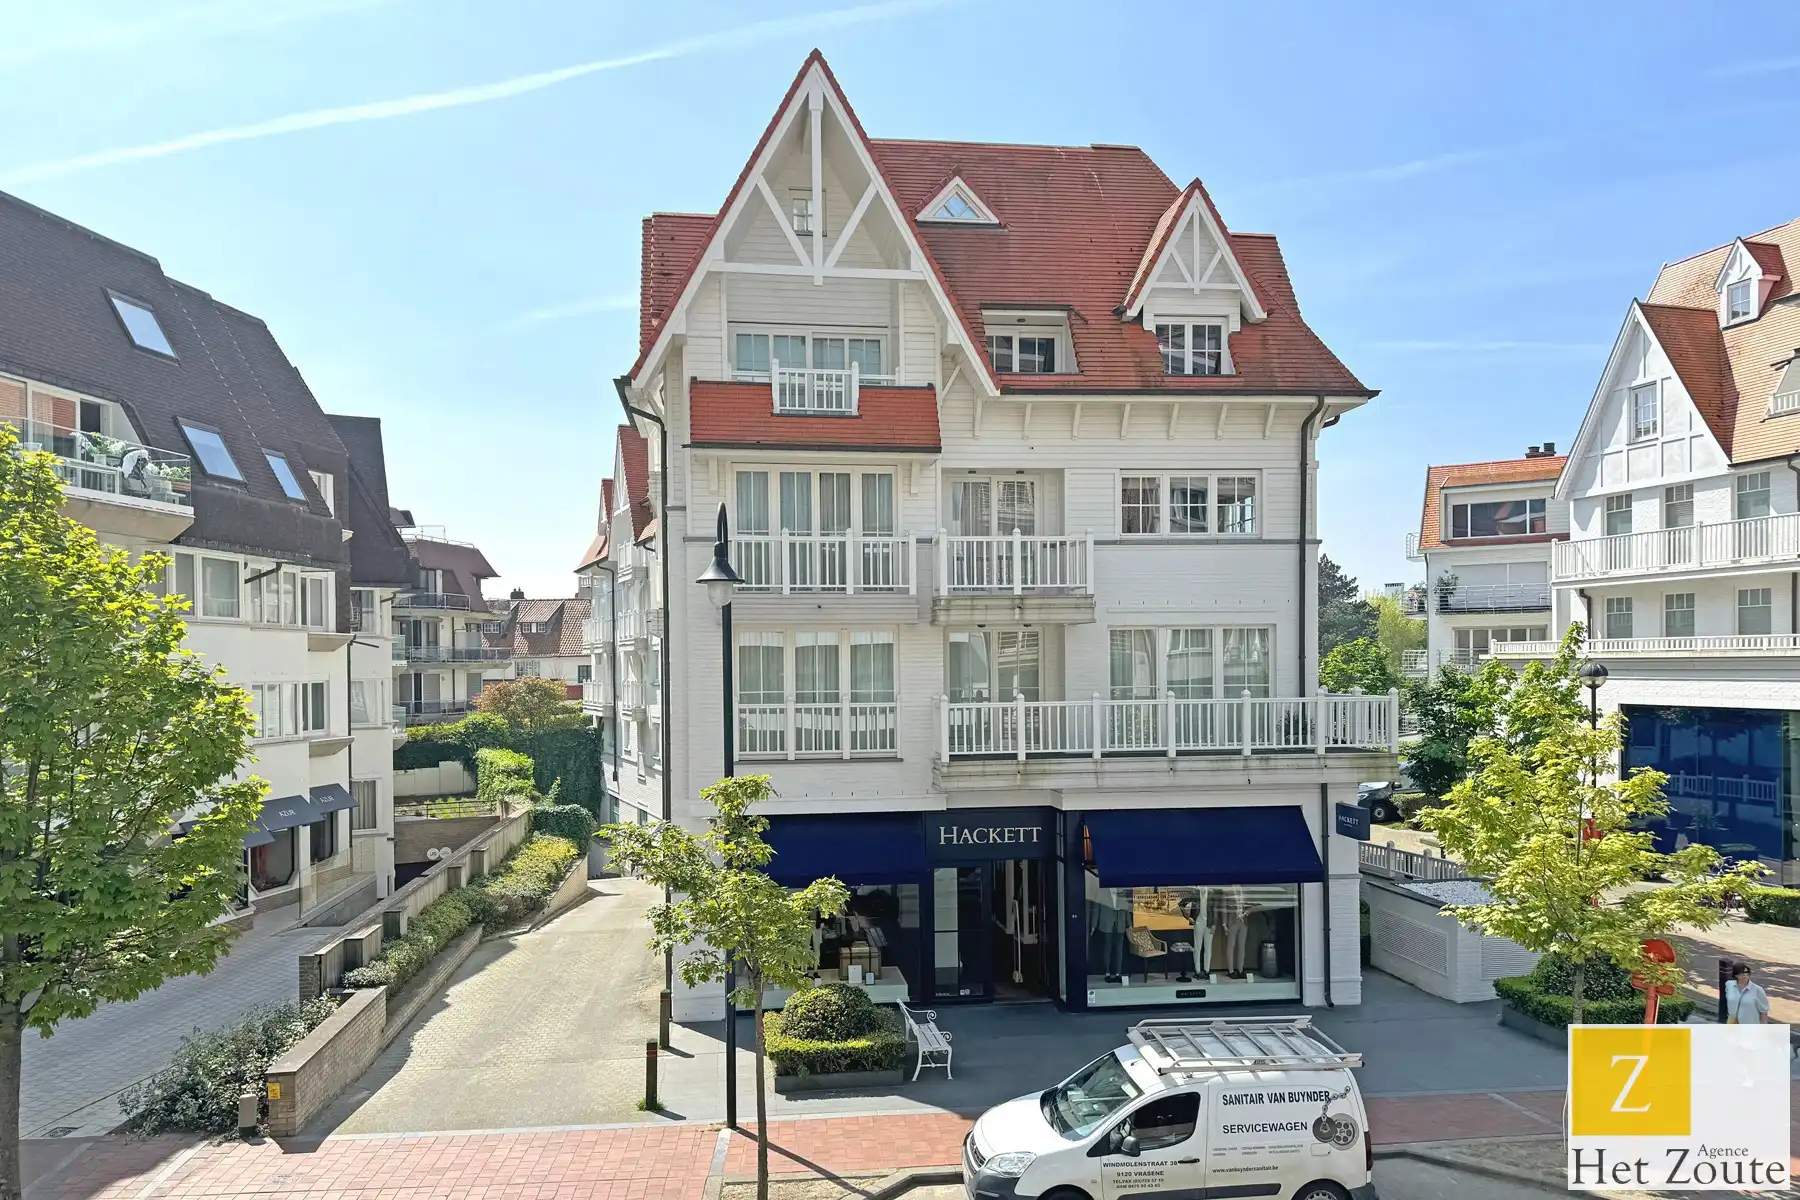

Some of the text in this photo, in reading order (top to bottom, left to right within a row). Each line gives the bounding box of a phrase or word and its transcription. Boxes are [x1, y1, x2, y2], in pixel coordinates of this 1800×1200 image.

[319, 795, 335, 804] AZUR
[278, 809, 297, 817] AZUR
[1338, 815, 1359, 825] HACKETT
[938, 826, 1042, 845] HACKETT
[1222, 1091, 1331, 1106] SANITAIR VAN BUYNDER
[1222, 1121, 1308, 1134] SERVICEWAGEN
[1102, 1160, 1168, 1168] WINDMOLENSTRAAT
[1211, 1165, 1279, 1174] www.vanbuyndersanitair.be
